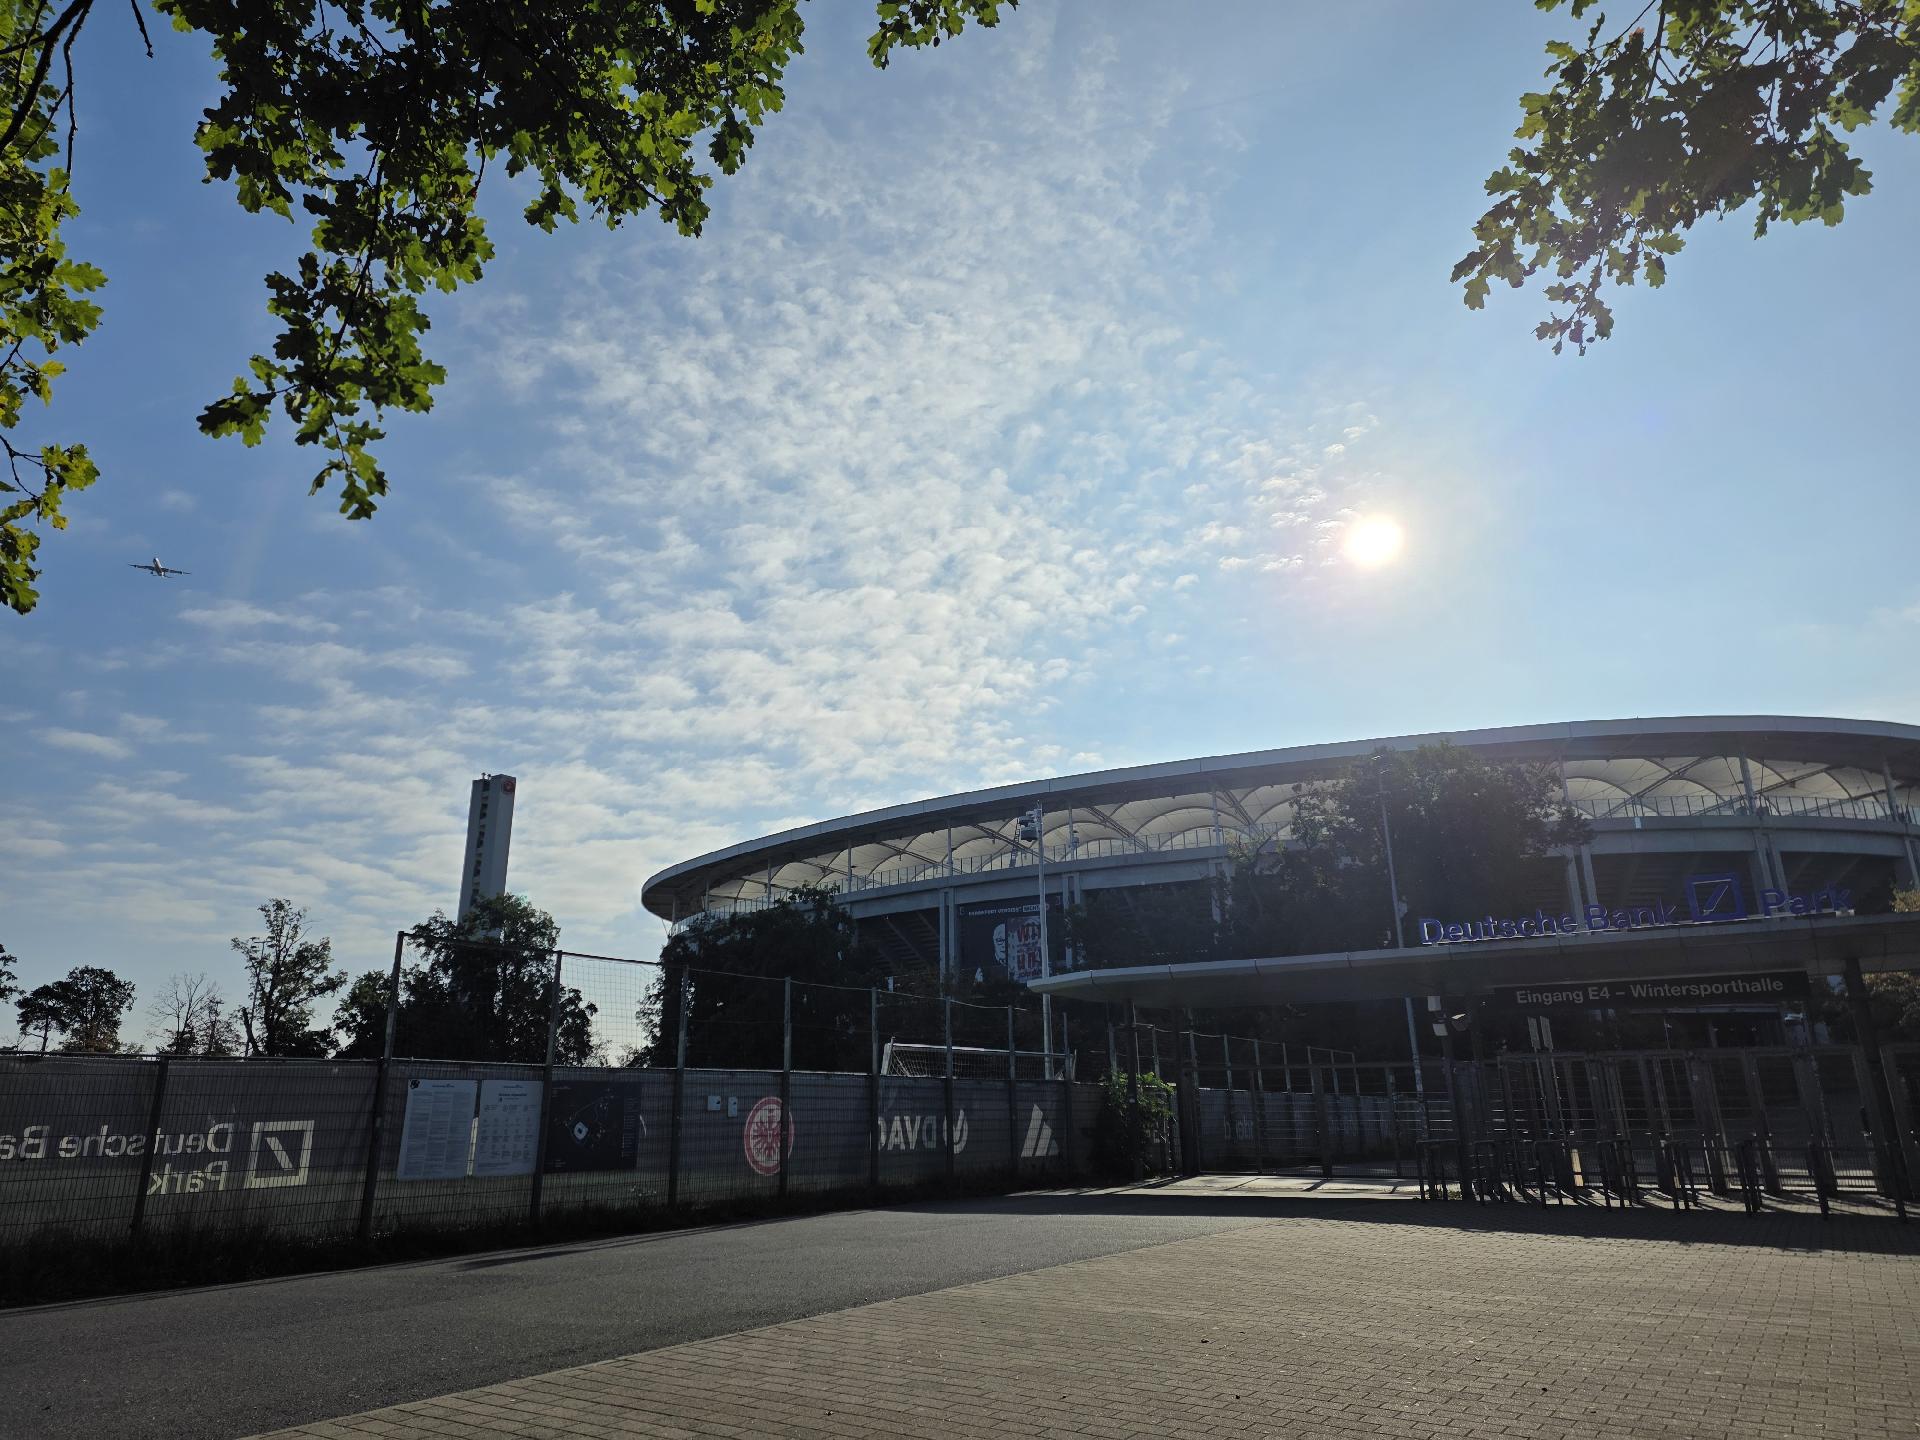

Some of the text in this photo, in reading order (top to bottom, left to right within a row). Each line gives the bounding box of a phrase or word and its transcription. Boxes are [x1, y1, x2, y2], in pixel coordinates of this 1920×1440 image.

[1420, 883, 1852, 944] Deutsche Bank Park
[1516, 987, 1584, 1006] Eingang
[1588, 984, 1610, 1001] E4
[1630, 978, 1784, 999] Wintersporthalle
